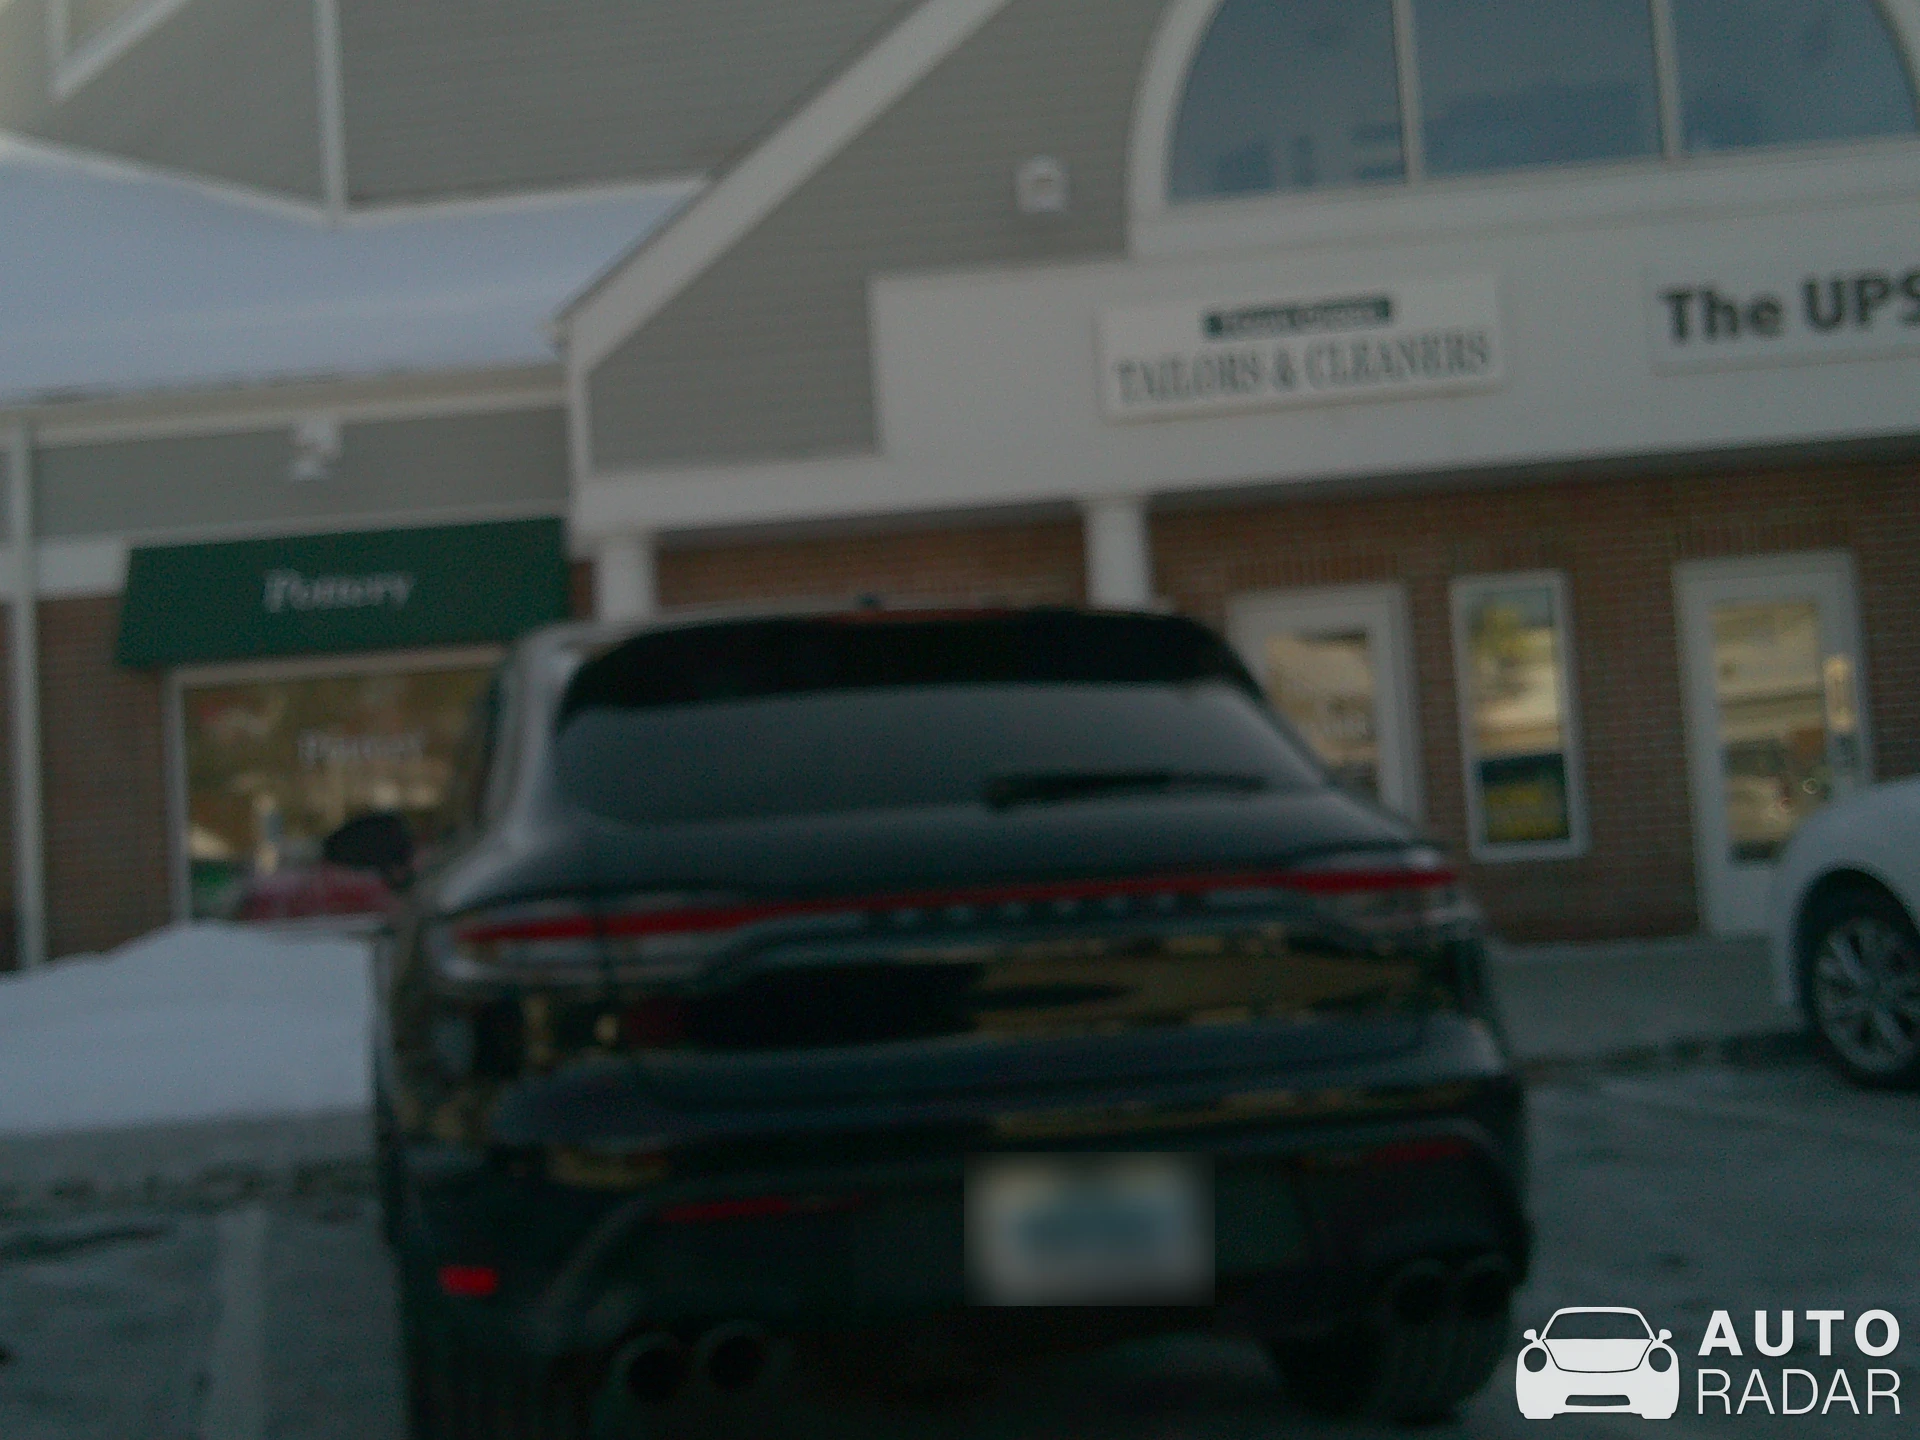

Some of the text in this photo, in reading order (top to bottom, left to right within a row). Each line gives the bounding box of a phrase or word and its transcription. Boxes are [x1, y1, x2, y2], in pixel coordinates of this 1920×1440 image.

[1657, 265, 1920, 345] The UPS
[1113, 328, 1491, 404] TAILORS & CLEANERS
[263, 568, 415, 612] Pottery
